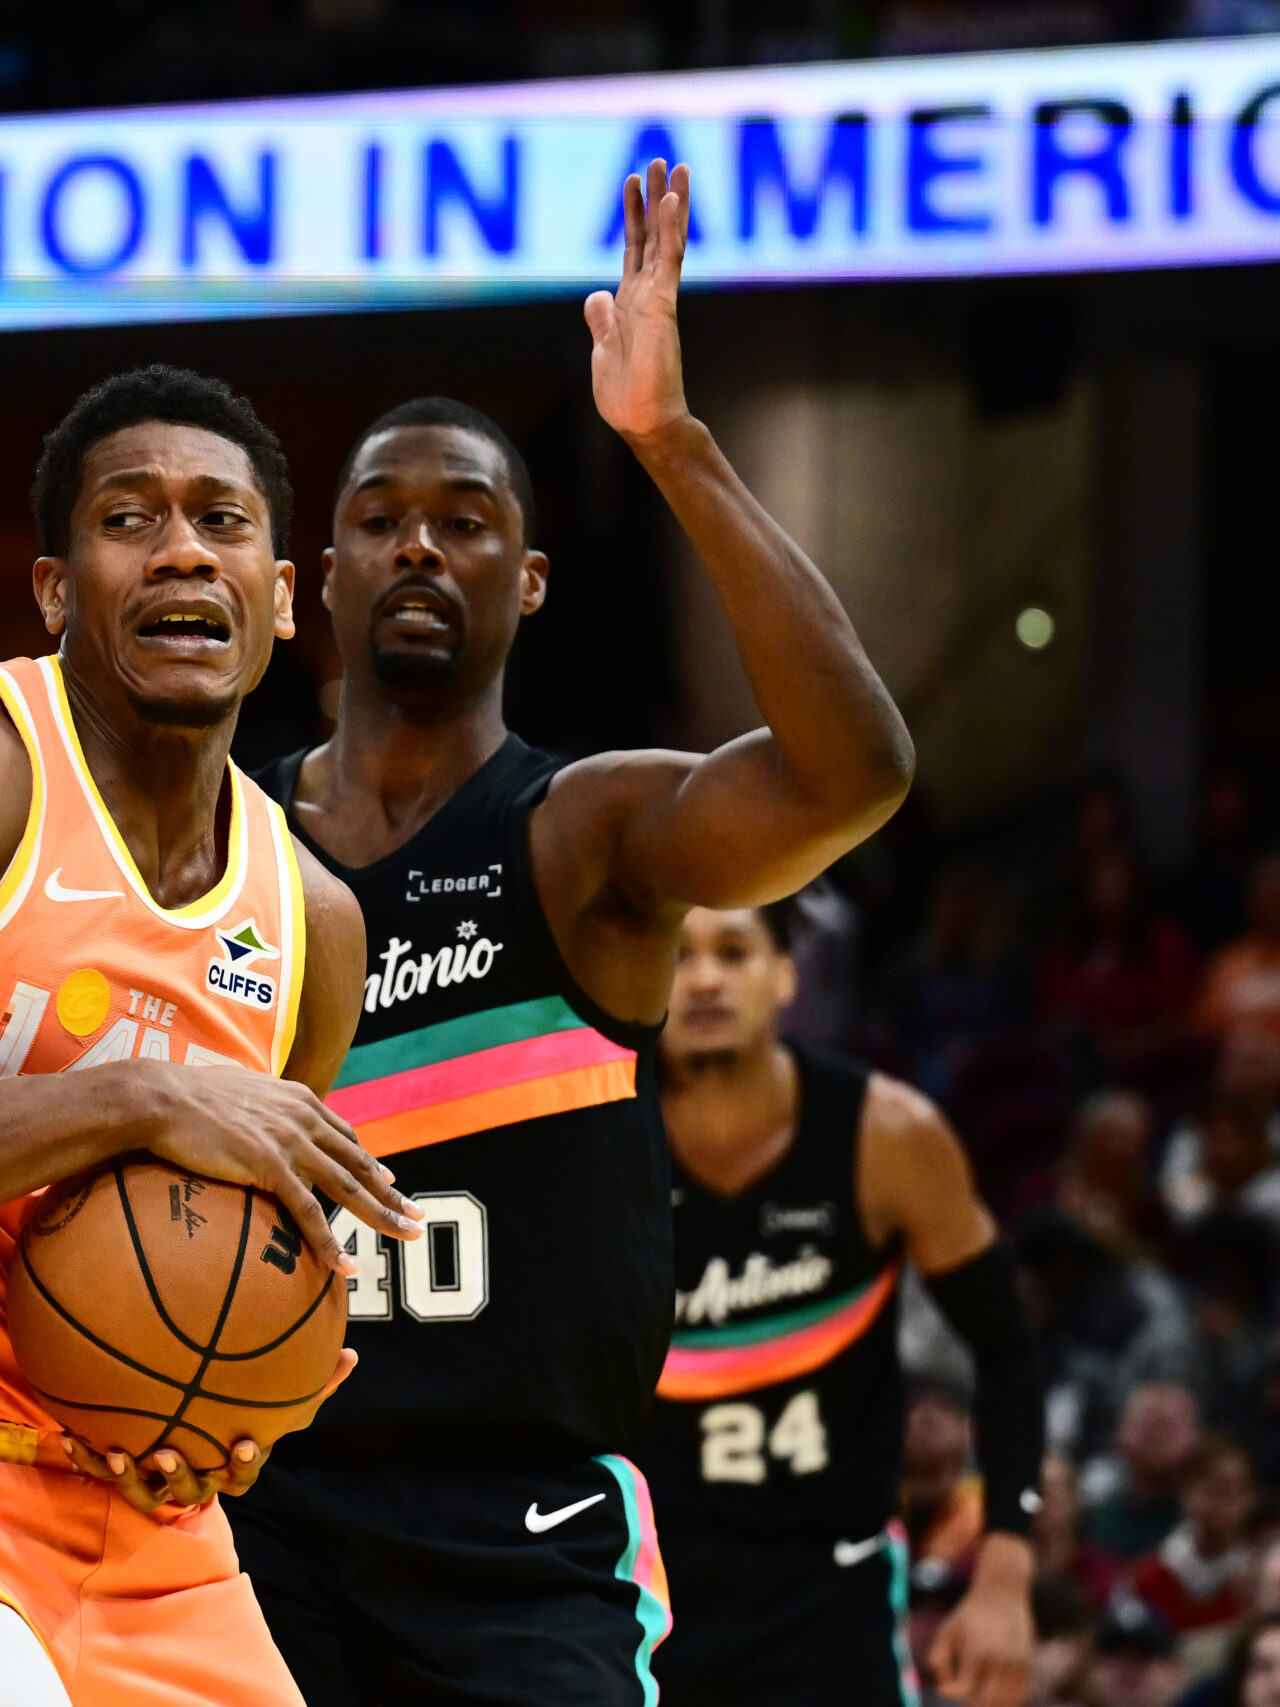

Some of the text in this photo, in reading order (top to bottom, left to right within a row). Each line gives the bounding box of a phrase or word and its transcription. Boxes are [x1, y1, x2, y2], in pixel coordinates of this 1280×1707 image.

[362, 130, 517, 264] IN
[419, 873, 490, 893] LEDGER
[128, 989, 179, 1028] THE
[207, 964, 273, 1005] CLIFFS
[364, 919, 504, 1013] ntonio
[327, 1190, 489, 1323] 40
[699, 1388, 828, 1486] 24
